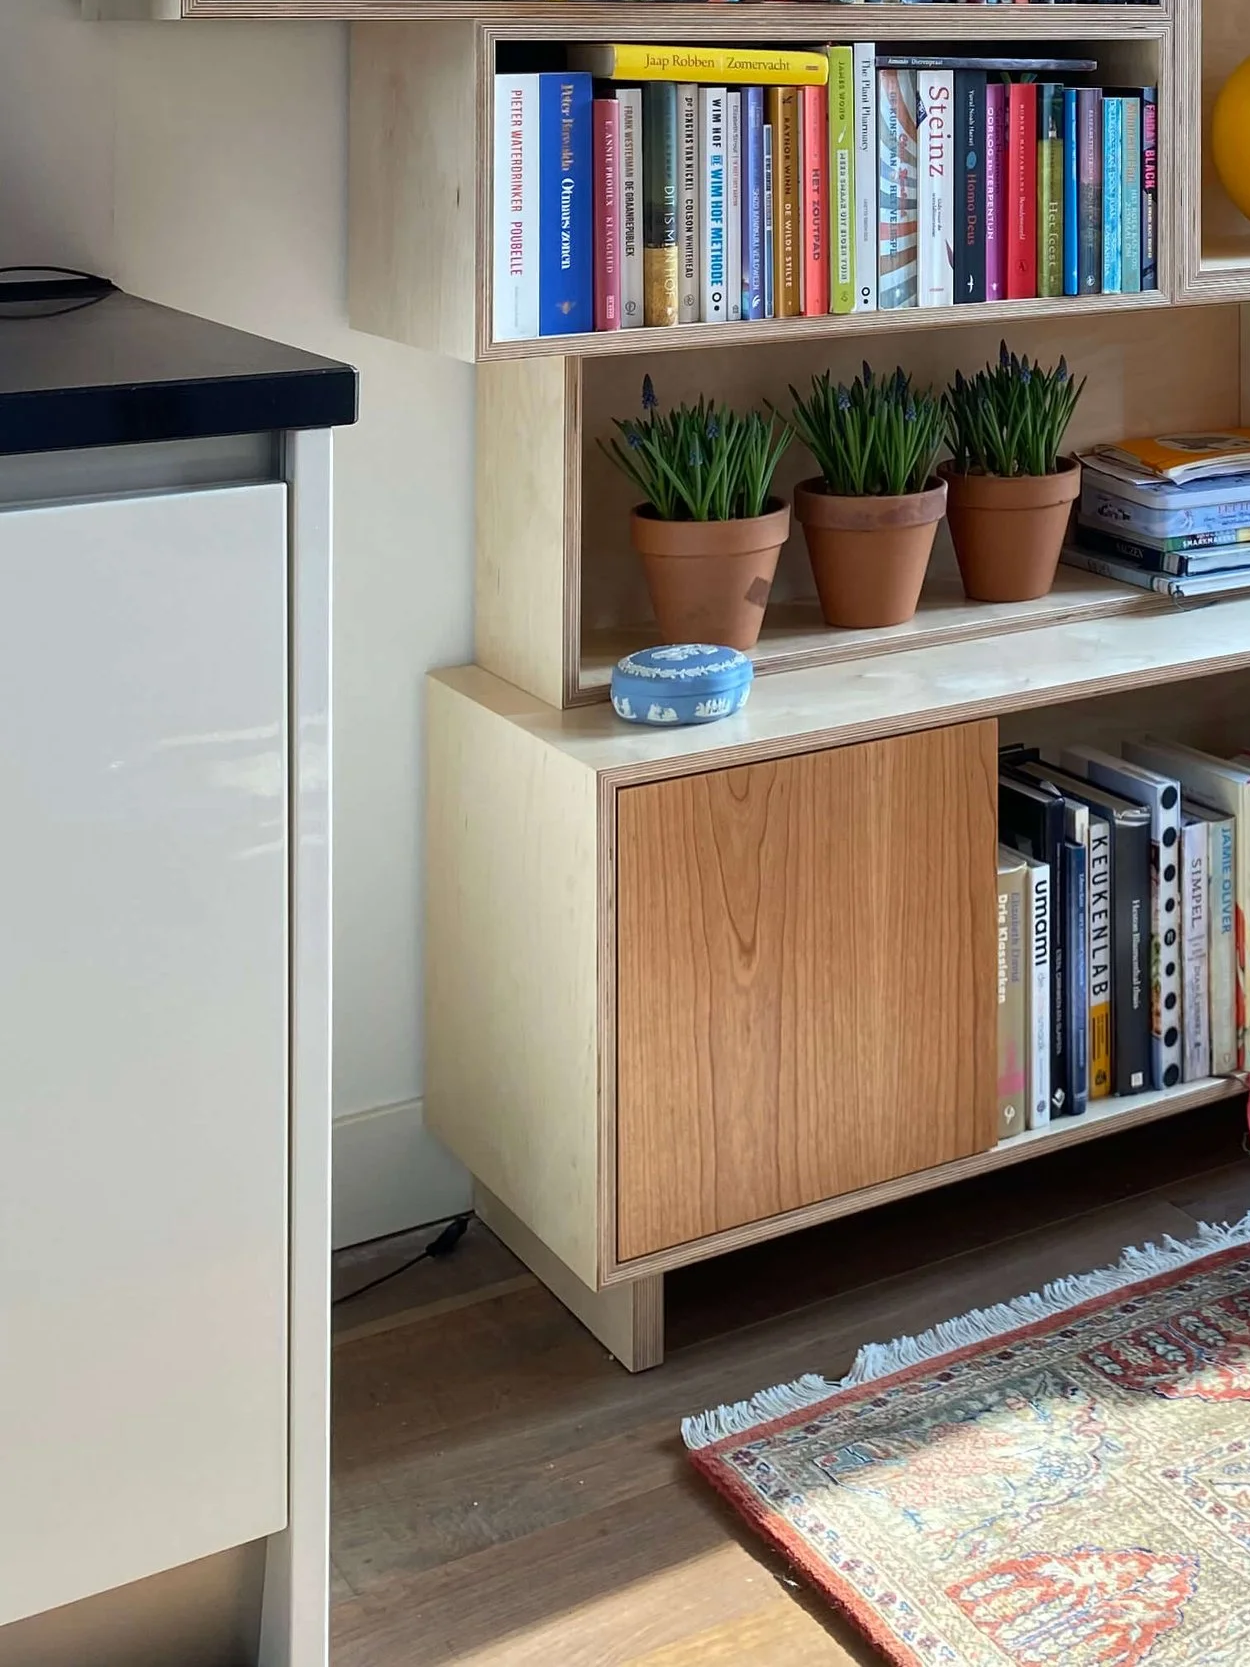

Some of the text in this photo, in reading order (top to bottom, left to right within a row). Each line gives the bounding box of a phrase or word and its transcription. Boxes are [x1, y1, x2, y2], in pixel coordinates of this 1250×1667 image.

[645, 54, 790, 70] Jaap Robben Zomervacht
[511, 90, 522, 126] PIETER
[784, 117, 792, 161] RAYNOR
[860, 59, 871, 151] The Plant Pharmacy
[928, 86, 951, 177] Steinz
[511, 130, 523, 212] WATERDRINKER
[605, 133, 613, 163] ANNIE
[624, 106, 635, 257] FRANK WESTERMAN DE GRAANREPUBLIEK
[784, 165, 792, 195] WINN
[1145, 105, 1155, 188] FRIDAY BLACK
[560, 178, 575, 269] Otmars zonen
[605, 167, 613, 206] PROULX
[664, 185, 674, 206] DIT
[664, 211, 675, 224] IS
[685, 109, 694, 278] JONGENS VAN NICKEL COLSON WHITEHEAD
[711, 99, 722, 286] WIM HOF DE WIM HOF METHODE
[785, 203, 792, 214] DE
[813, 169, 821, 261] HET ZOUTPAD
[966, 174, 977, 211] Homo
[510, 221, 523, 276] POUBELLE
[967, 215, 977, 245] Deus
[1049, 202, 1058, 267] Het feest
[664, 269, 675, 298] HOF
[1091, 836, 1109, 997] KEUKENLAB
[1191, 858, 1203, 927] SIMPEL
[1221, 827, 1232, 934] JAMIE OLIVER
[998, 894, 1009, 1005] Drie Klassieken
[1010, 892, 1022, 983] Elizabeth David
[1034, 880, 1048, 967] umami
[1132, 900, 1141, 1010] Heston Blumenthal thuis
